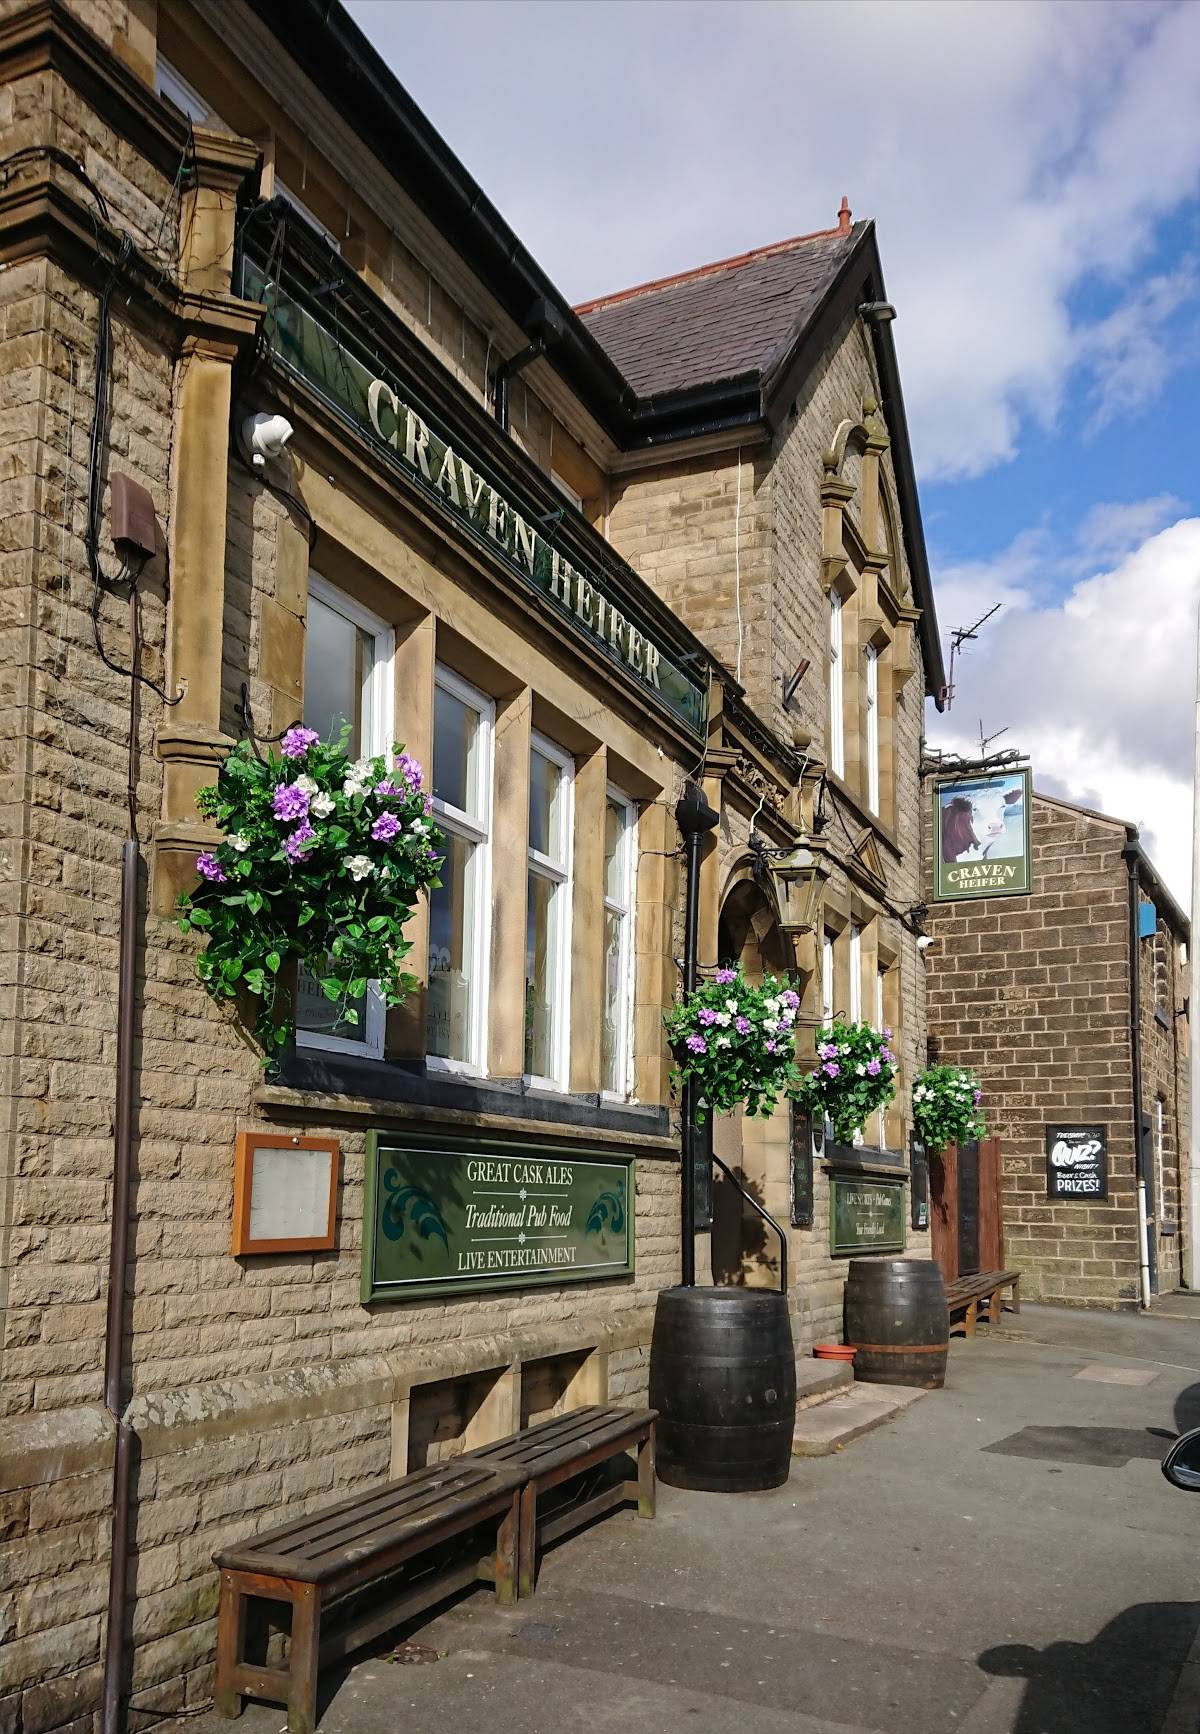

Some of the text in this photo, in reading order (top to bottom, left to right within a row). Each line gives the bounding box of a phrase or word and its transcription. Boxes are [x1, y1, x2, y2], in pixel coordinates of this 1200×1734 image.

[367, 379, 661, 690] CRAVEN HEIFER
[947, 864, 1017, 883] CRAVEN
[959, 876, 1006, 889] HEIFER
[467, 1161, 573, 1186] GREAT CASK ALES
[1057, 1179, 1100, 1192] PRIZES!
[465, 1204, 573, 1229] Traditional Pub Food
[457, 1247, 577, 1271] LIVE ENTERTAINMENT
